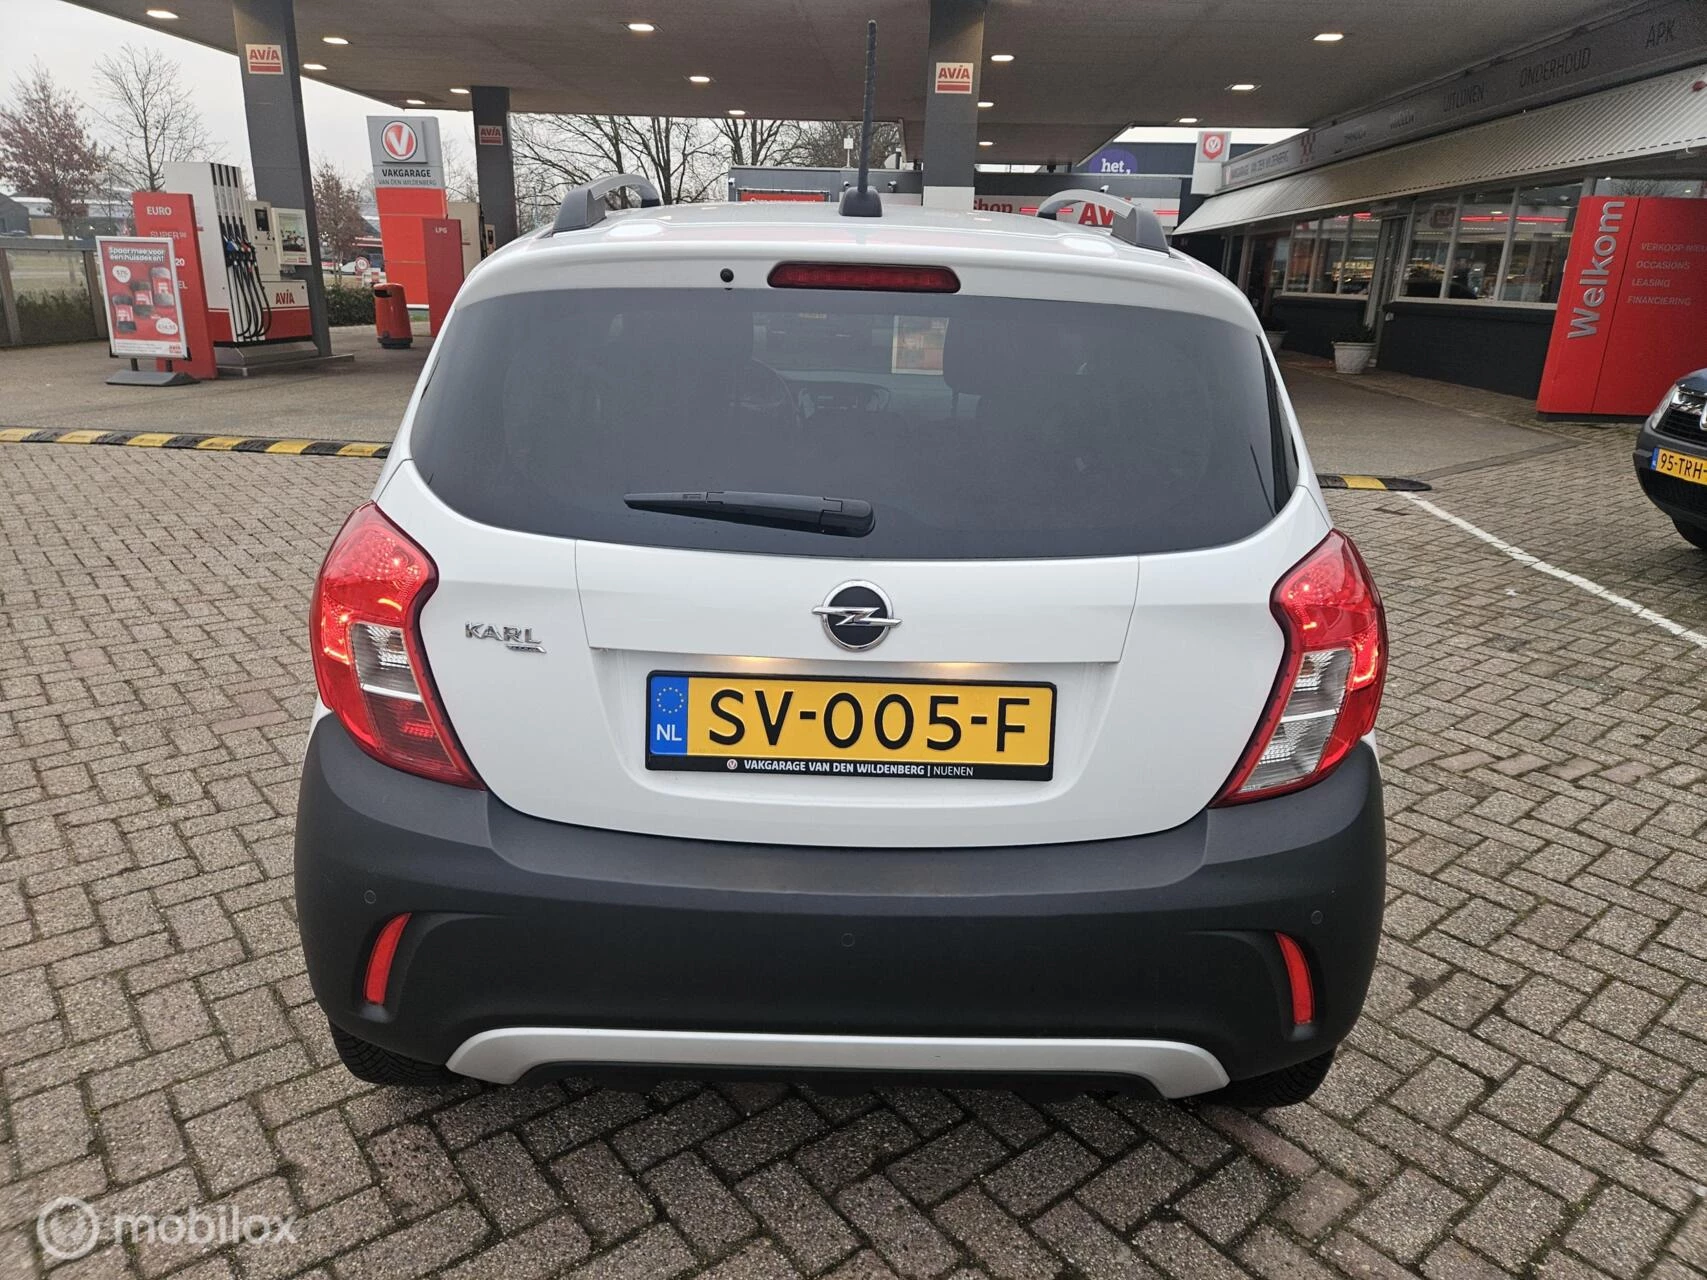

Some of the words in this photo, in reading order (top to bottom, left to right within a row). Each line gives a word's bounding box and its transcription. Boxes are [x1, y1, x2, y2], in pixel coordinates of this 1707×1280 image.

[1645, 17, 1677, 49] APK
[249, 46, 281, 60] AVIA
[938, 64, 971, 79] AVIA
[1519, 47, 1592, 88] ONDERHOUD
[480, 126, 501, 137] AVIA
[381, 168, 432, 178] VAKGARAGE
[146, 206, 172, 216] EURO
[1567, 201, 1626, 338] Welkom
[1636, 260, 1691, 270] OCCASIONS
[1632, 278, 1671, 288] LEASING
[275, 289, 295, 304] AVIA
[1627, 296, 1692, 306] FINANCIERING
[465, 623, 542, 644] KARL
[708, 688, 1031, 753] SV-005-F
[656, 723, 682, 742] NL
[744, 759, 806, 771] VAKGARAGE
[808, 761, 830, 772] VAN
[833, 762, 854, 773] DEN
[857, 763, 925, 776] WILDENBERG
[933, 765, 974, 777] NUENEN
